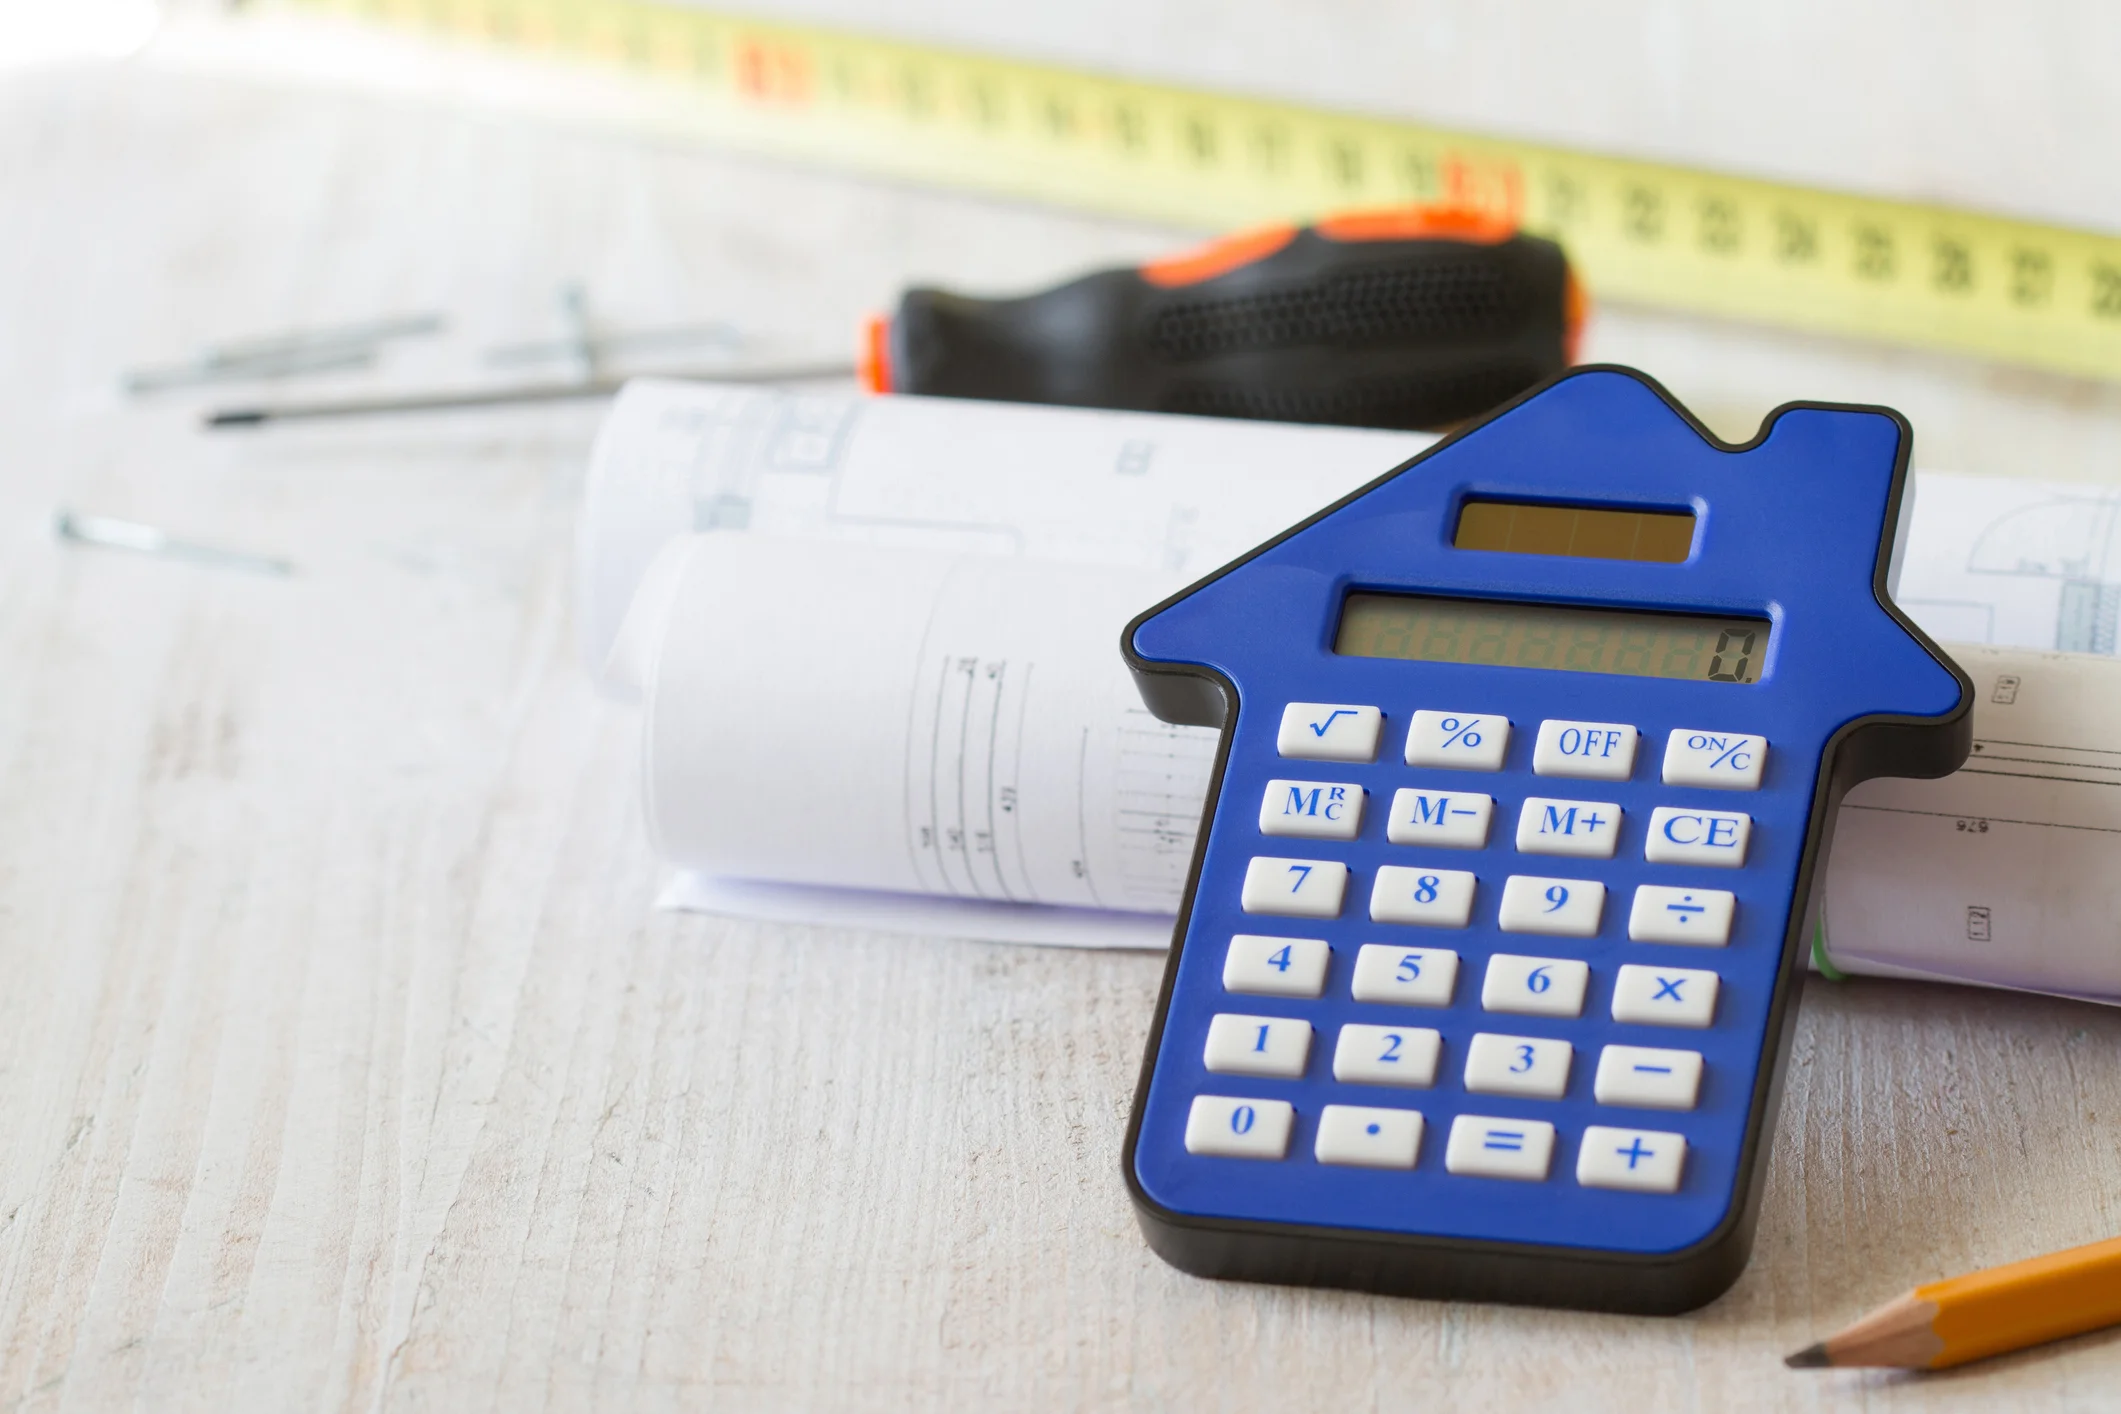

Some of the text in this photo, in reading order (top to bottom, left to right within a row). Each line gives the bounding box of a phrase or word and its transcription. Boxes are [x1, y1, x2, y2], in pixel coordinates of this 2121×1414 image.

[1441, 718, 1482, 748] %
[1560, 728, 1621, 757] OFF
[1688, 733, 1753, 770] ON/C
[1541, 805, 1605, 835] M+
[1664, 816, 1739, 848] CE
[1289, 865, 1312, 892] 7
[1414, 876, 1440, 903] 8
[1545, 886, 1569, 911] 9
[1268, 945, 1291, 973] 4
[1397, 954, 1422, 982] 5
[1527, 968, 1551, 993] 6
[1255, 1025, 1269, 1052] 1
[1379, 1034, 1402, 1063] 2
[1510, 1045, 1534, 1072] 3
[1231, 1107, 1255, 1134] 0
[1484, 1131, 1524, 1151] =
[1617, 1137, 1654, 1170] +
